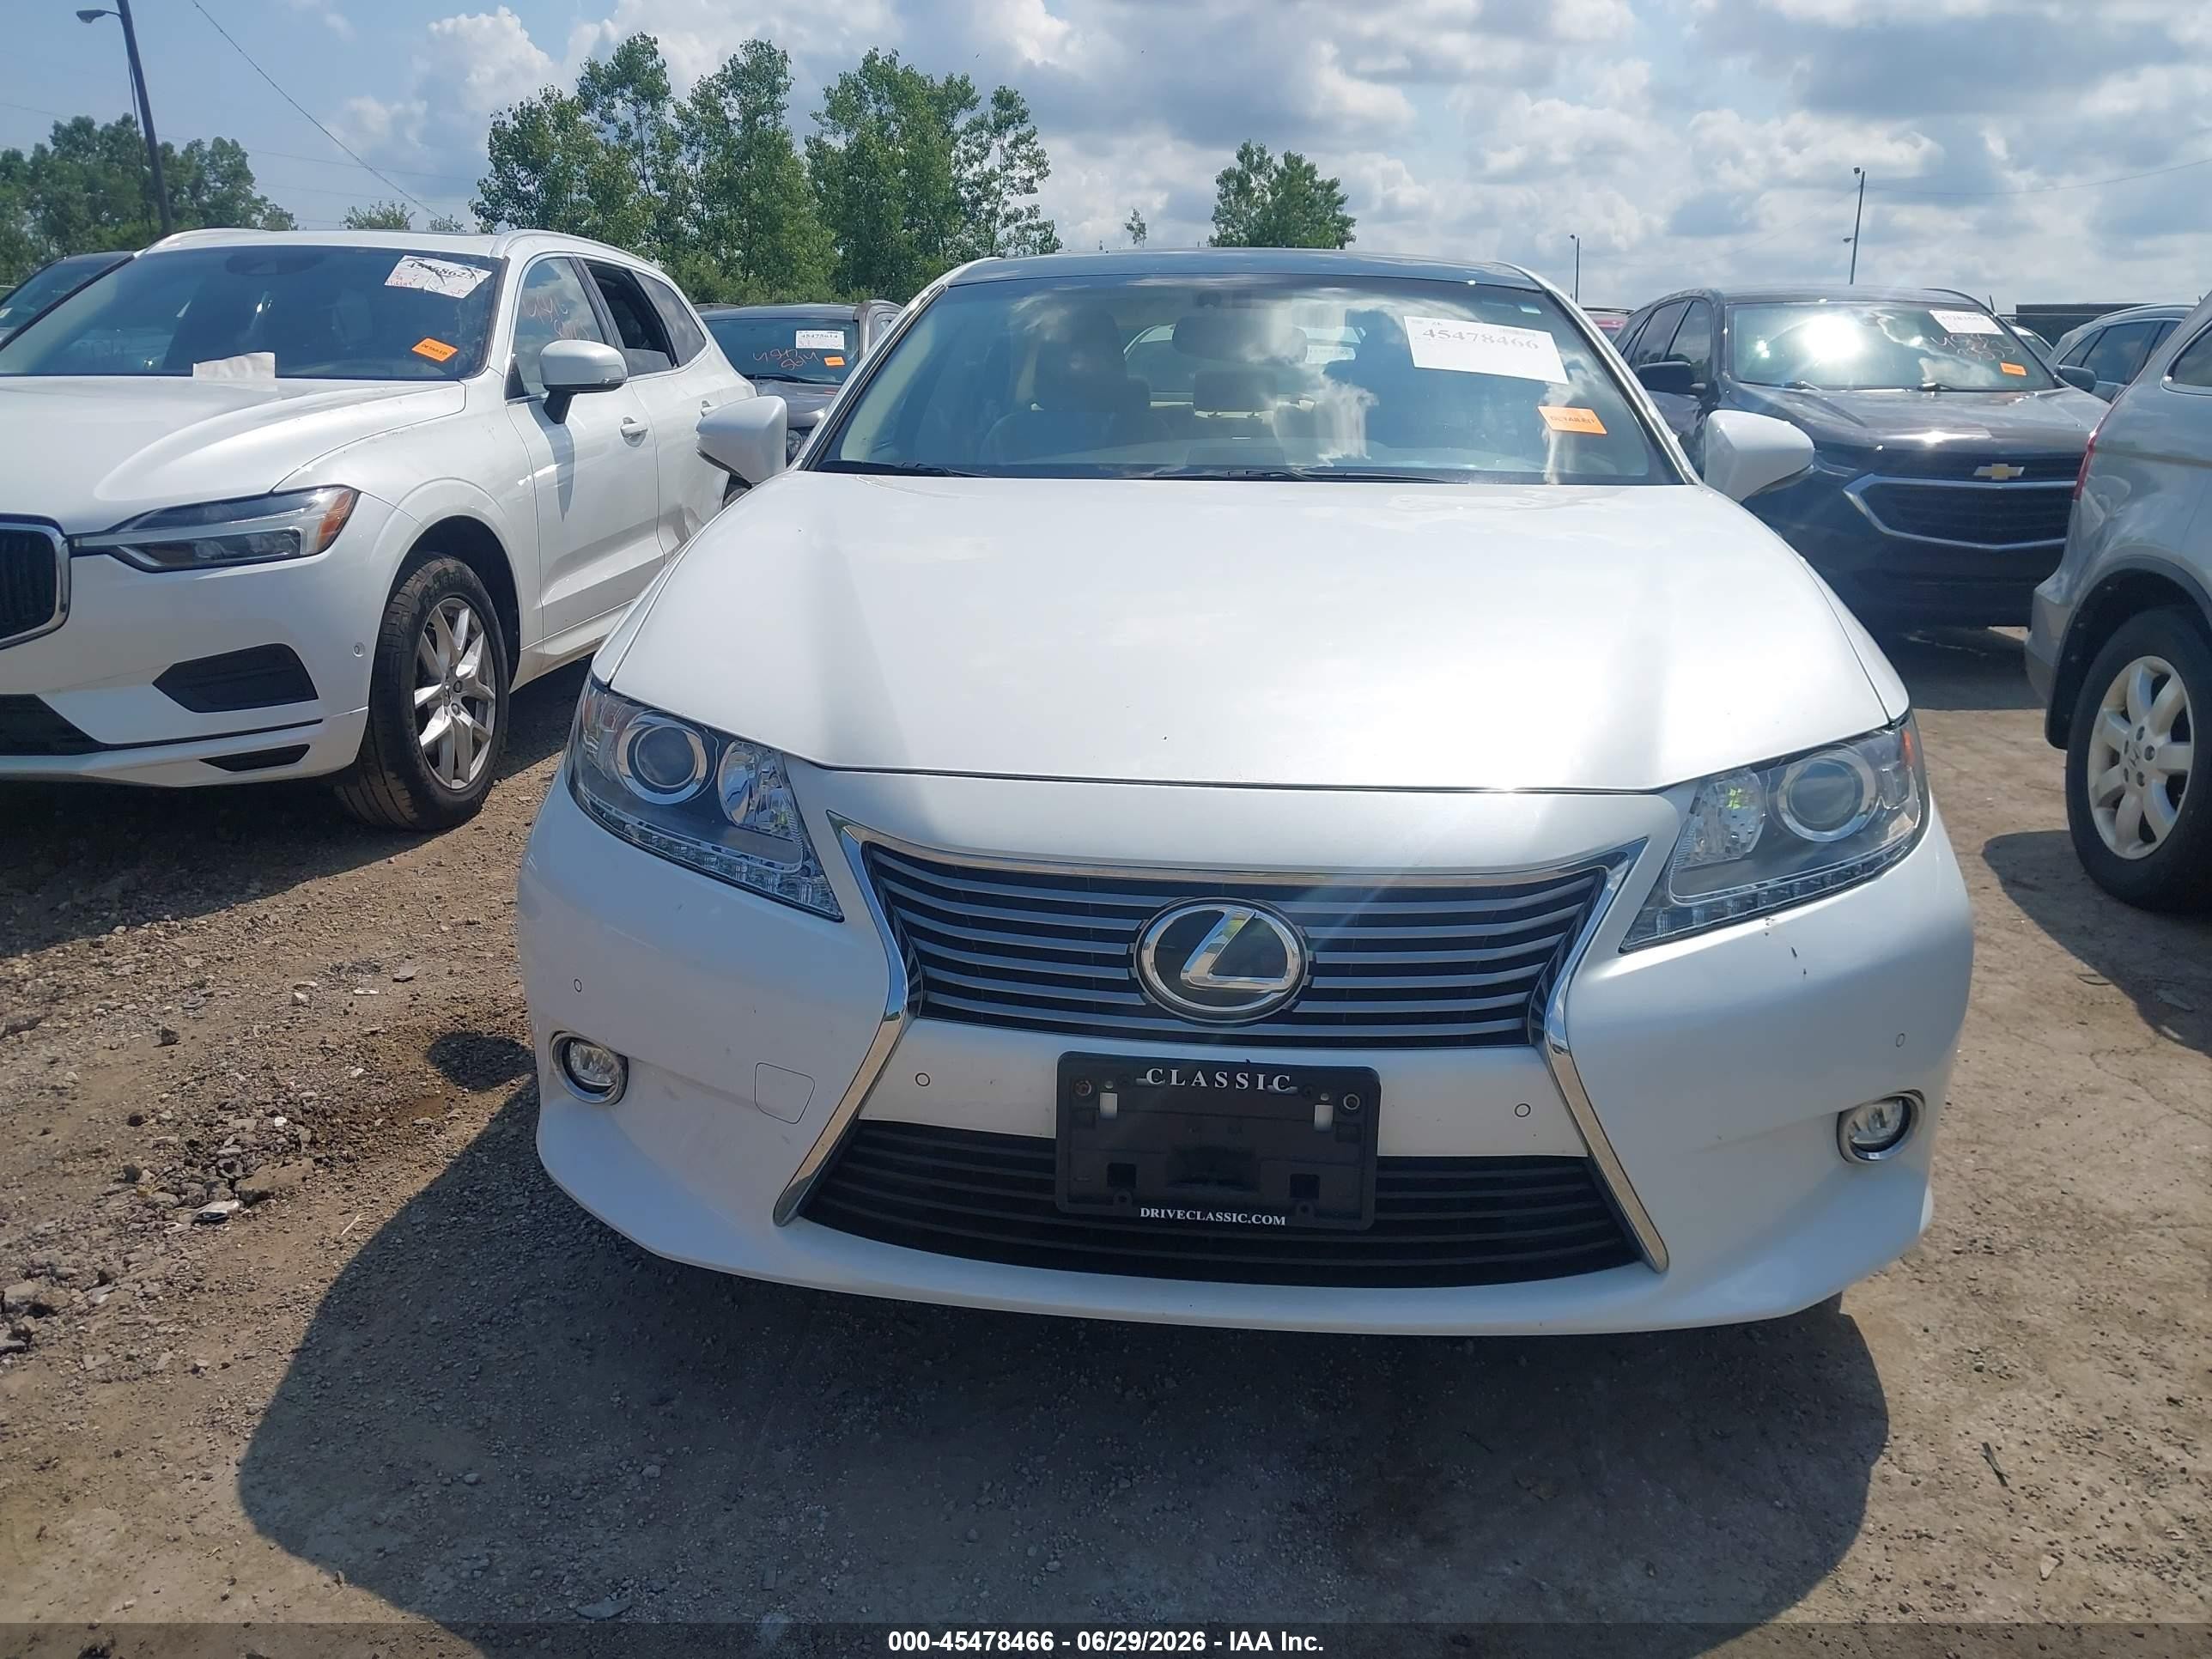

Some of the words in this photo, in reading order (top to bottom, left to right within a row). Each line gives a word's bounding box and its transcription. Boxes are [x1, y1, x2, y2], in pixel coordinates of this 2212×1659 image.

[1422, 329, 1540, 350] 45478466
[1145, 1066, 1292, 1093] CLASSIC
[1139, 1206, 1287, 1227] DRIVECLASSIC.COM
